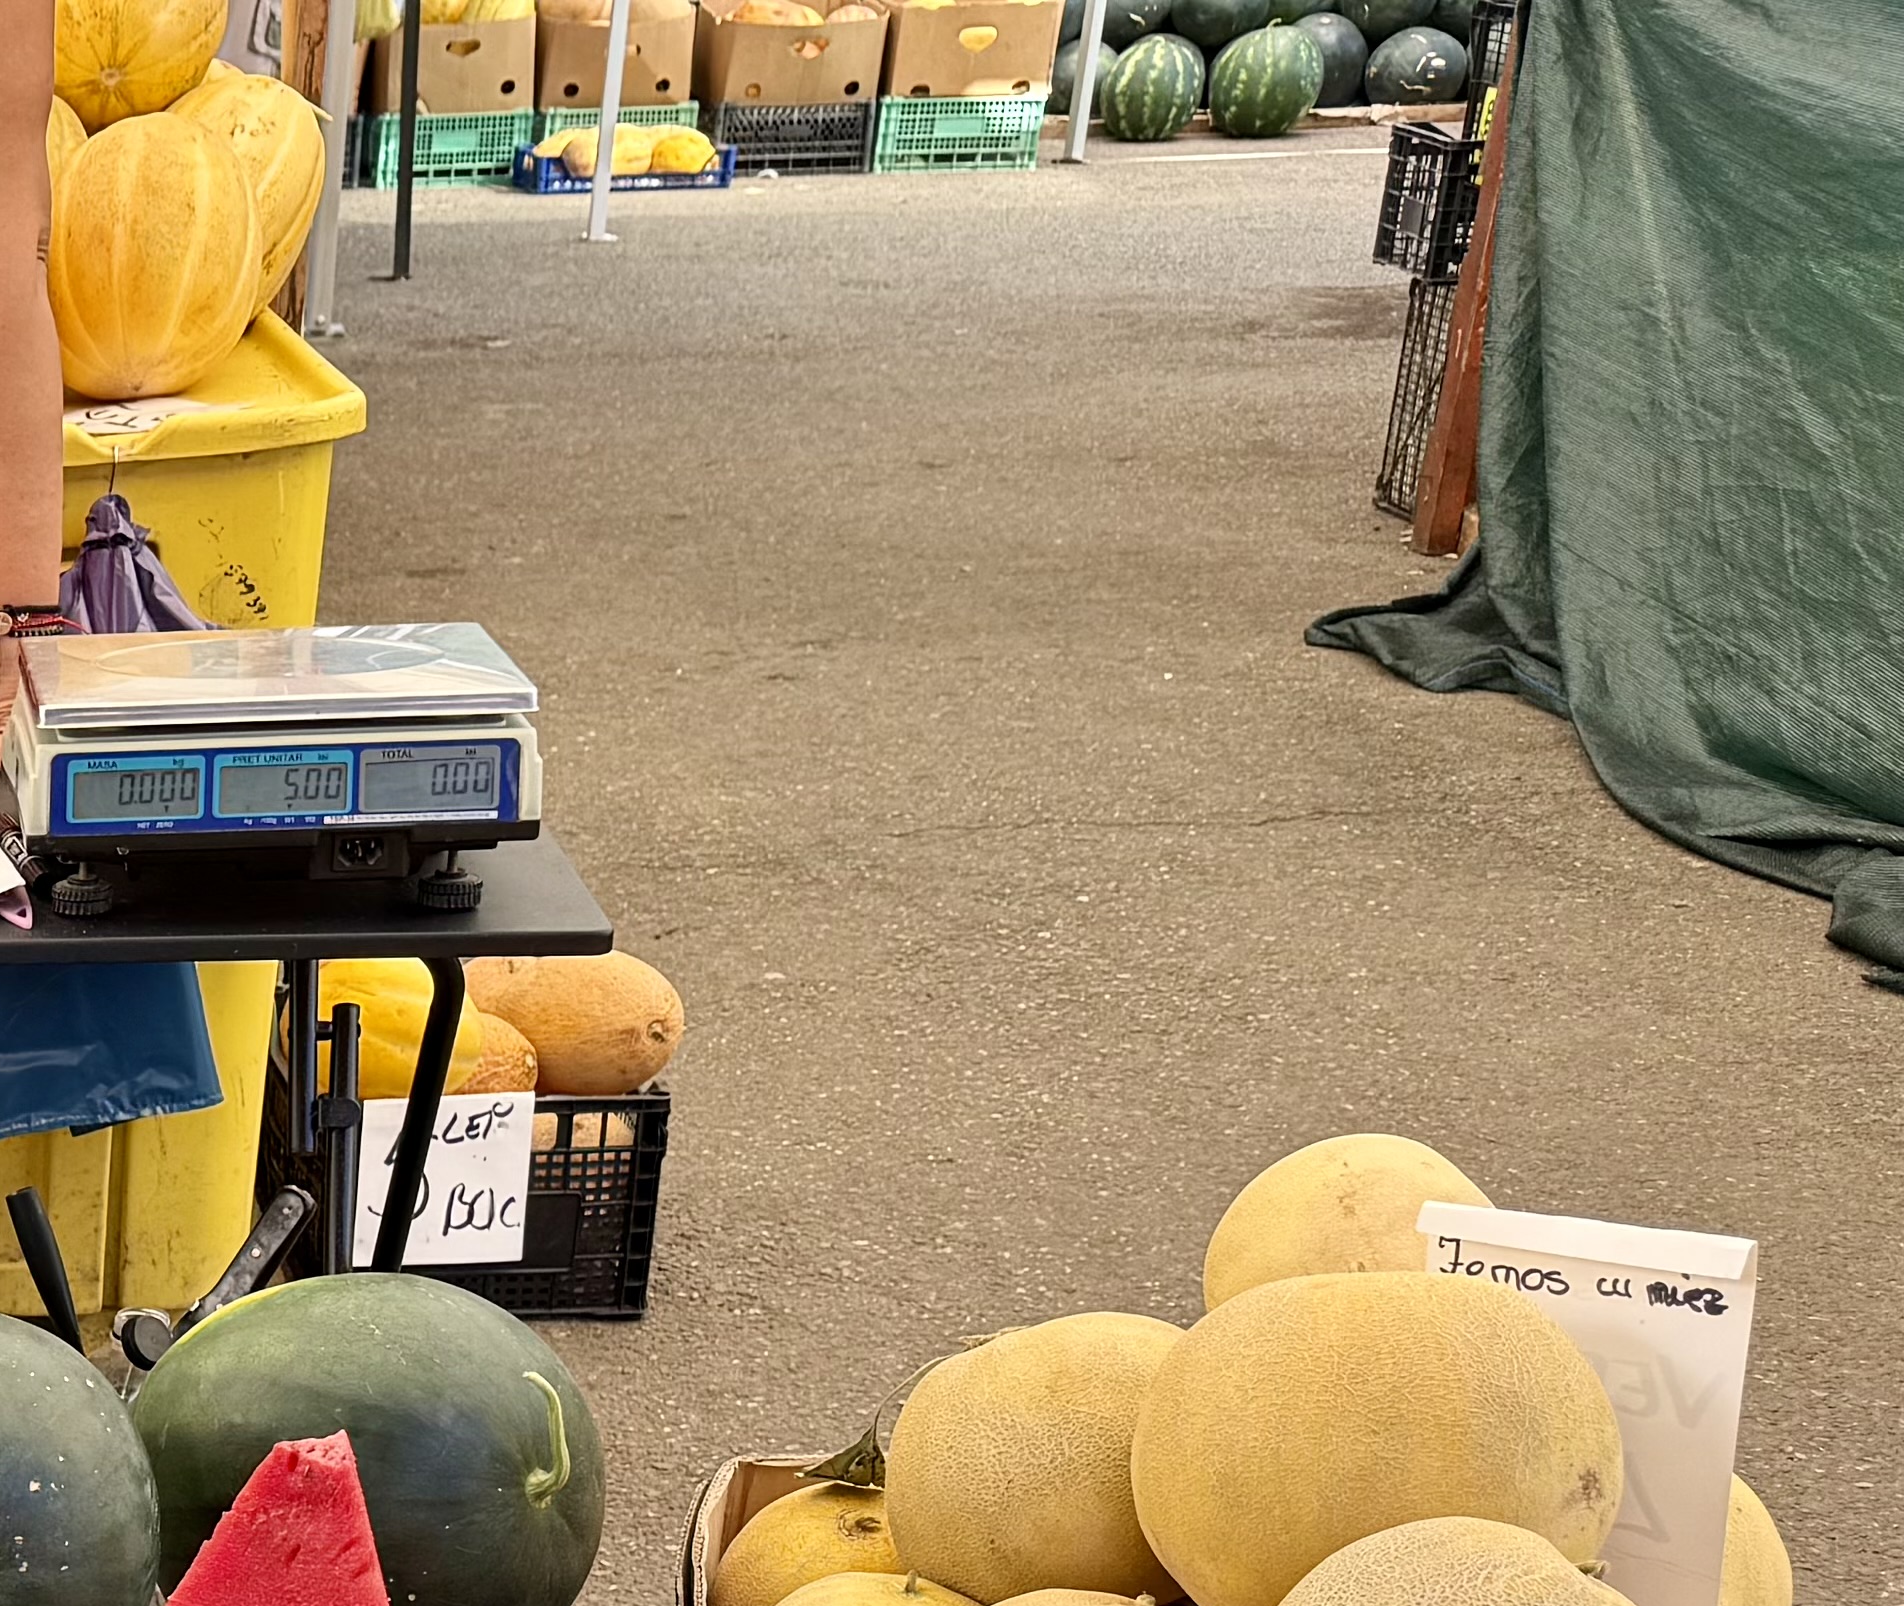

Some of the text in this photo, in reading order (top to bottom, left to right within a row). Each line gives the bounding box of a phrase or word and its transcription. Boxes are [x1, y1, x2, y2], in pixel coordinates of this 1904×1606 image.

[382, 749, 414, 759] TOTAL
[118, 770, 197, 805] 0.000
[284, 767, 343, 800] 5.00
[431, 761, 491, 796] 0.00
